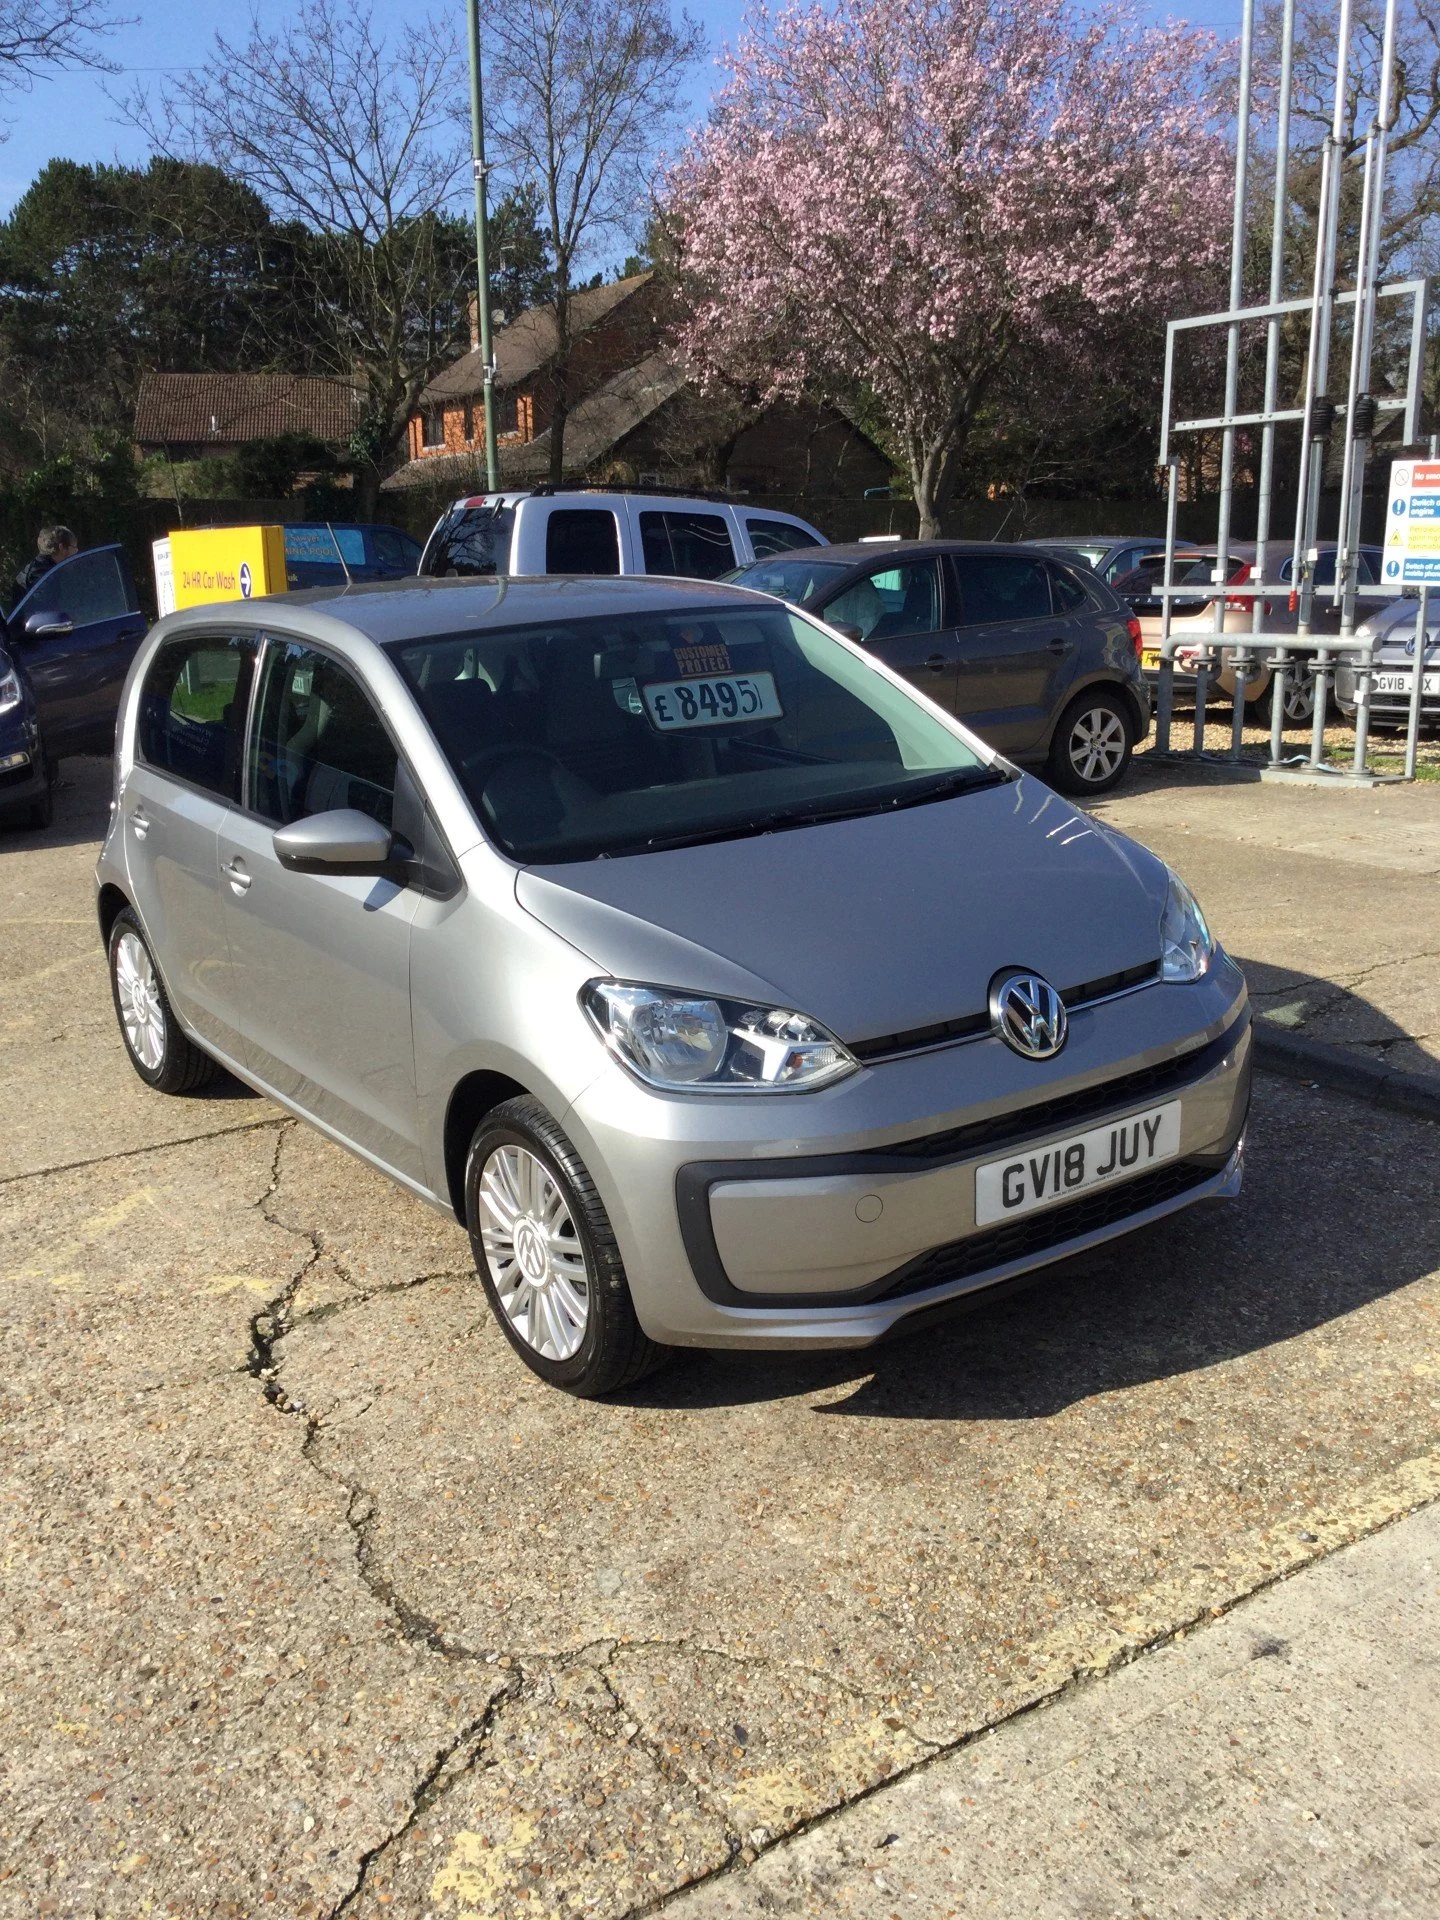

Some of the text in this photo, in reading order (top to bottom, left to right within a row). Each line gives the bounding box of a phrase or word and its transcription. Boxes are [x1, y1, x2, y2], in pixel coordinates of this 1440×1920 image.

[183, 570, 236, 590] 24 HR Car Wash
[673, 644, 729, 660] CUSTOMER
[677, 656, 733, 674] PROTECT
[1379, 677, 1405, 690] GV18
[1002, 1142, 1086, 1209] GV18
[1096, 1114, 1162, 1177] JUY
